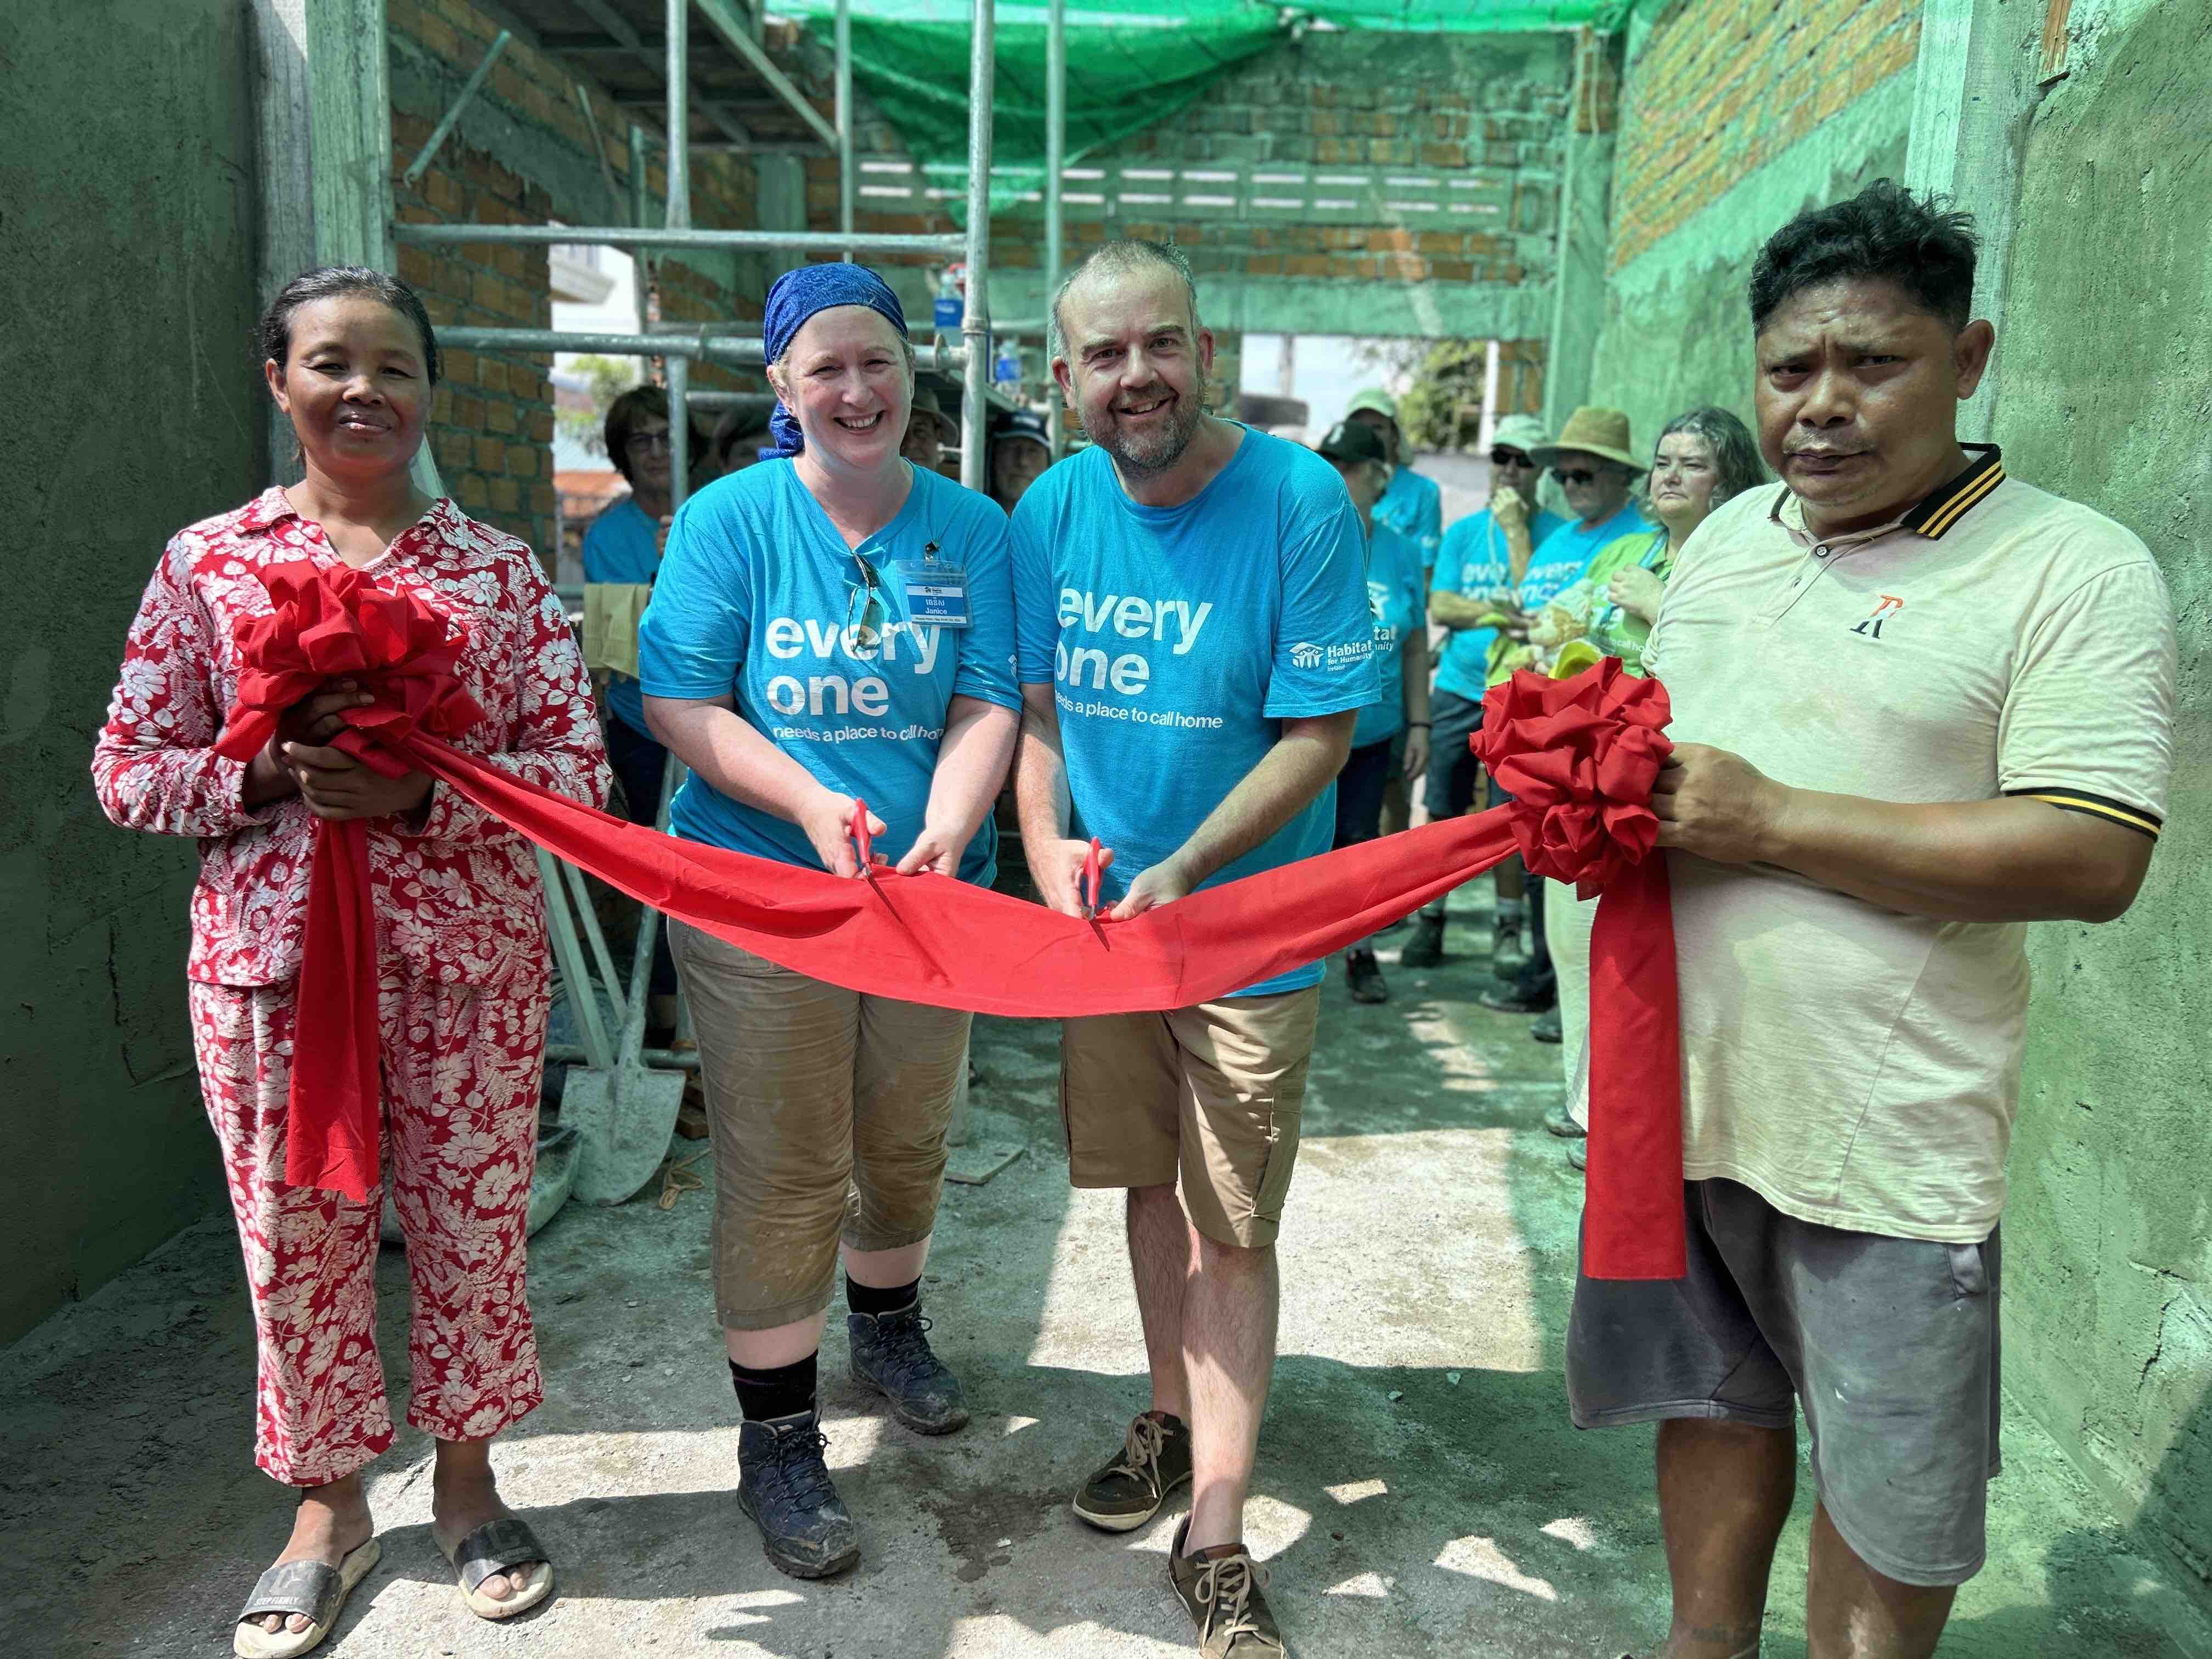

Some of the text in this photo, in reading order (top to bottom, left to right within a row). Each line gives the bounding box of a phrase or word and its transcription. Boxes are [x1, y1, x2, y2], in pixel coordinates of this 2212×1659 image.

[1057, 588, 1214, 655] every
[766, 617, 940, 674] every
[1328, 640, 1372, 657] Habitat
[1056, 640, 1150, 695] one
[766, 675, 889, 716] one
[1075, 702, 1084, 713] a
[1086, 701, 1128, 720] place
[1132, 707, 1148, 723] to
[1150, 710, 1173, 726] call
[1176, 712, 1223, 729] home
[772, 726, 820, 742] needs
[823, 731, 833, 741] a
[834, 726, 878, 744] place
[880, 727, 898, 740] to
